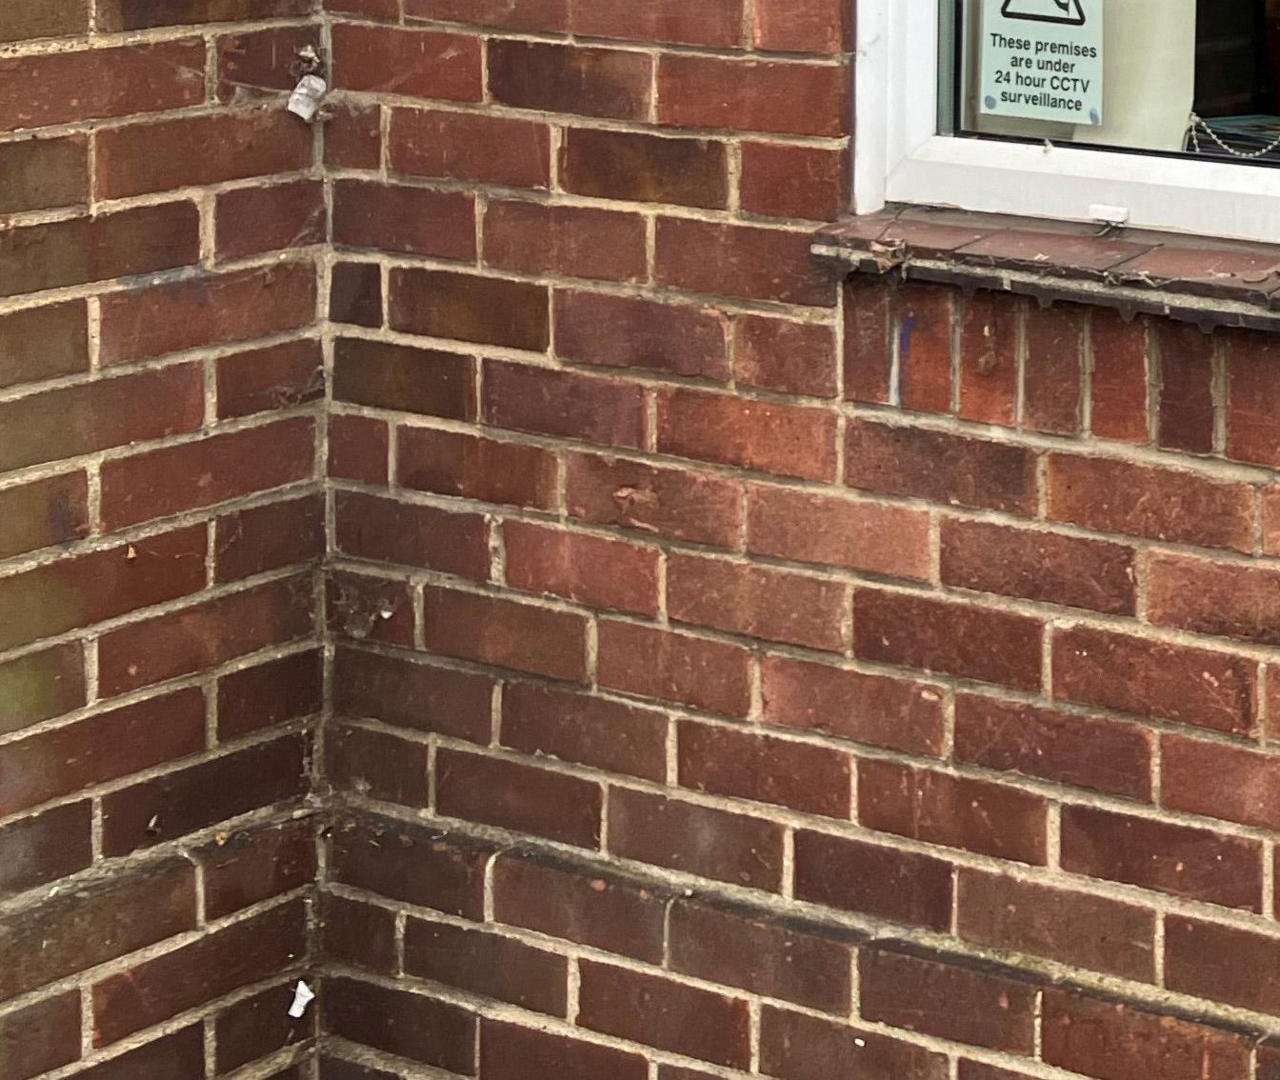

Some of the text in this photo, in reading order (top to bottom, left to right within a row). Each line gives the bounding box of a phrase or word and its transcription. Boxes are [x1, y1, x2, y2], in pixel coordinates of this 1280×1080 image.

[990, 33, 1096, 58] These premises
[1010, 56, 1075, 73] are under
[995, 70, 1090, 93] 24 hour CCTV
[1000, 91, 1082, 111] surveillance
